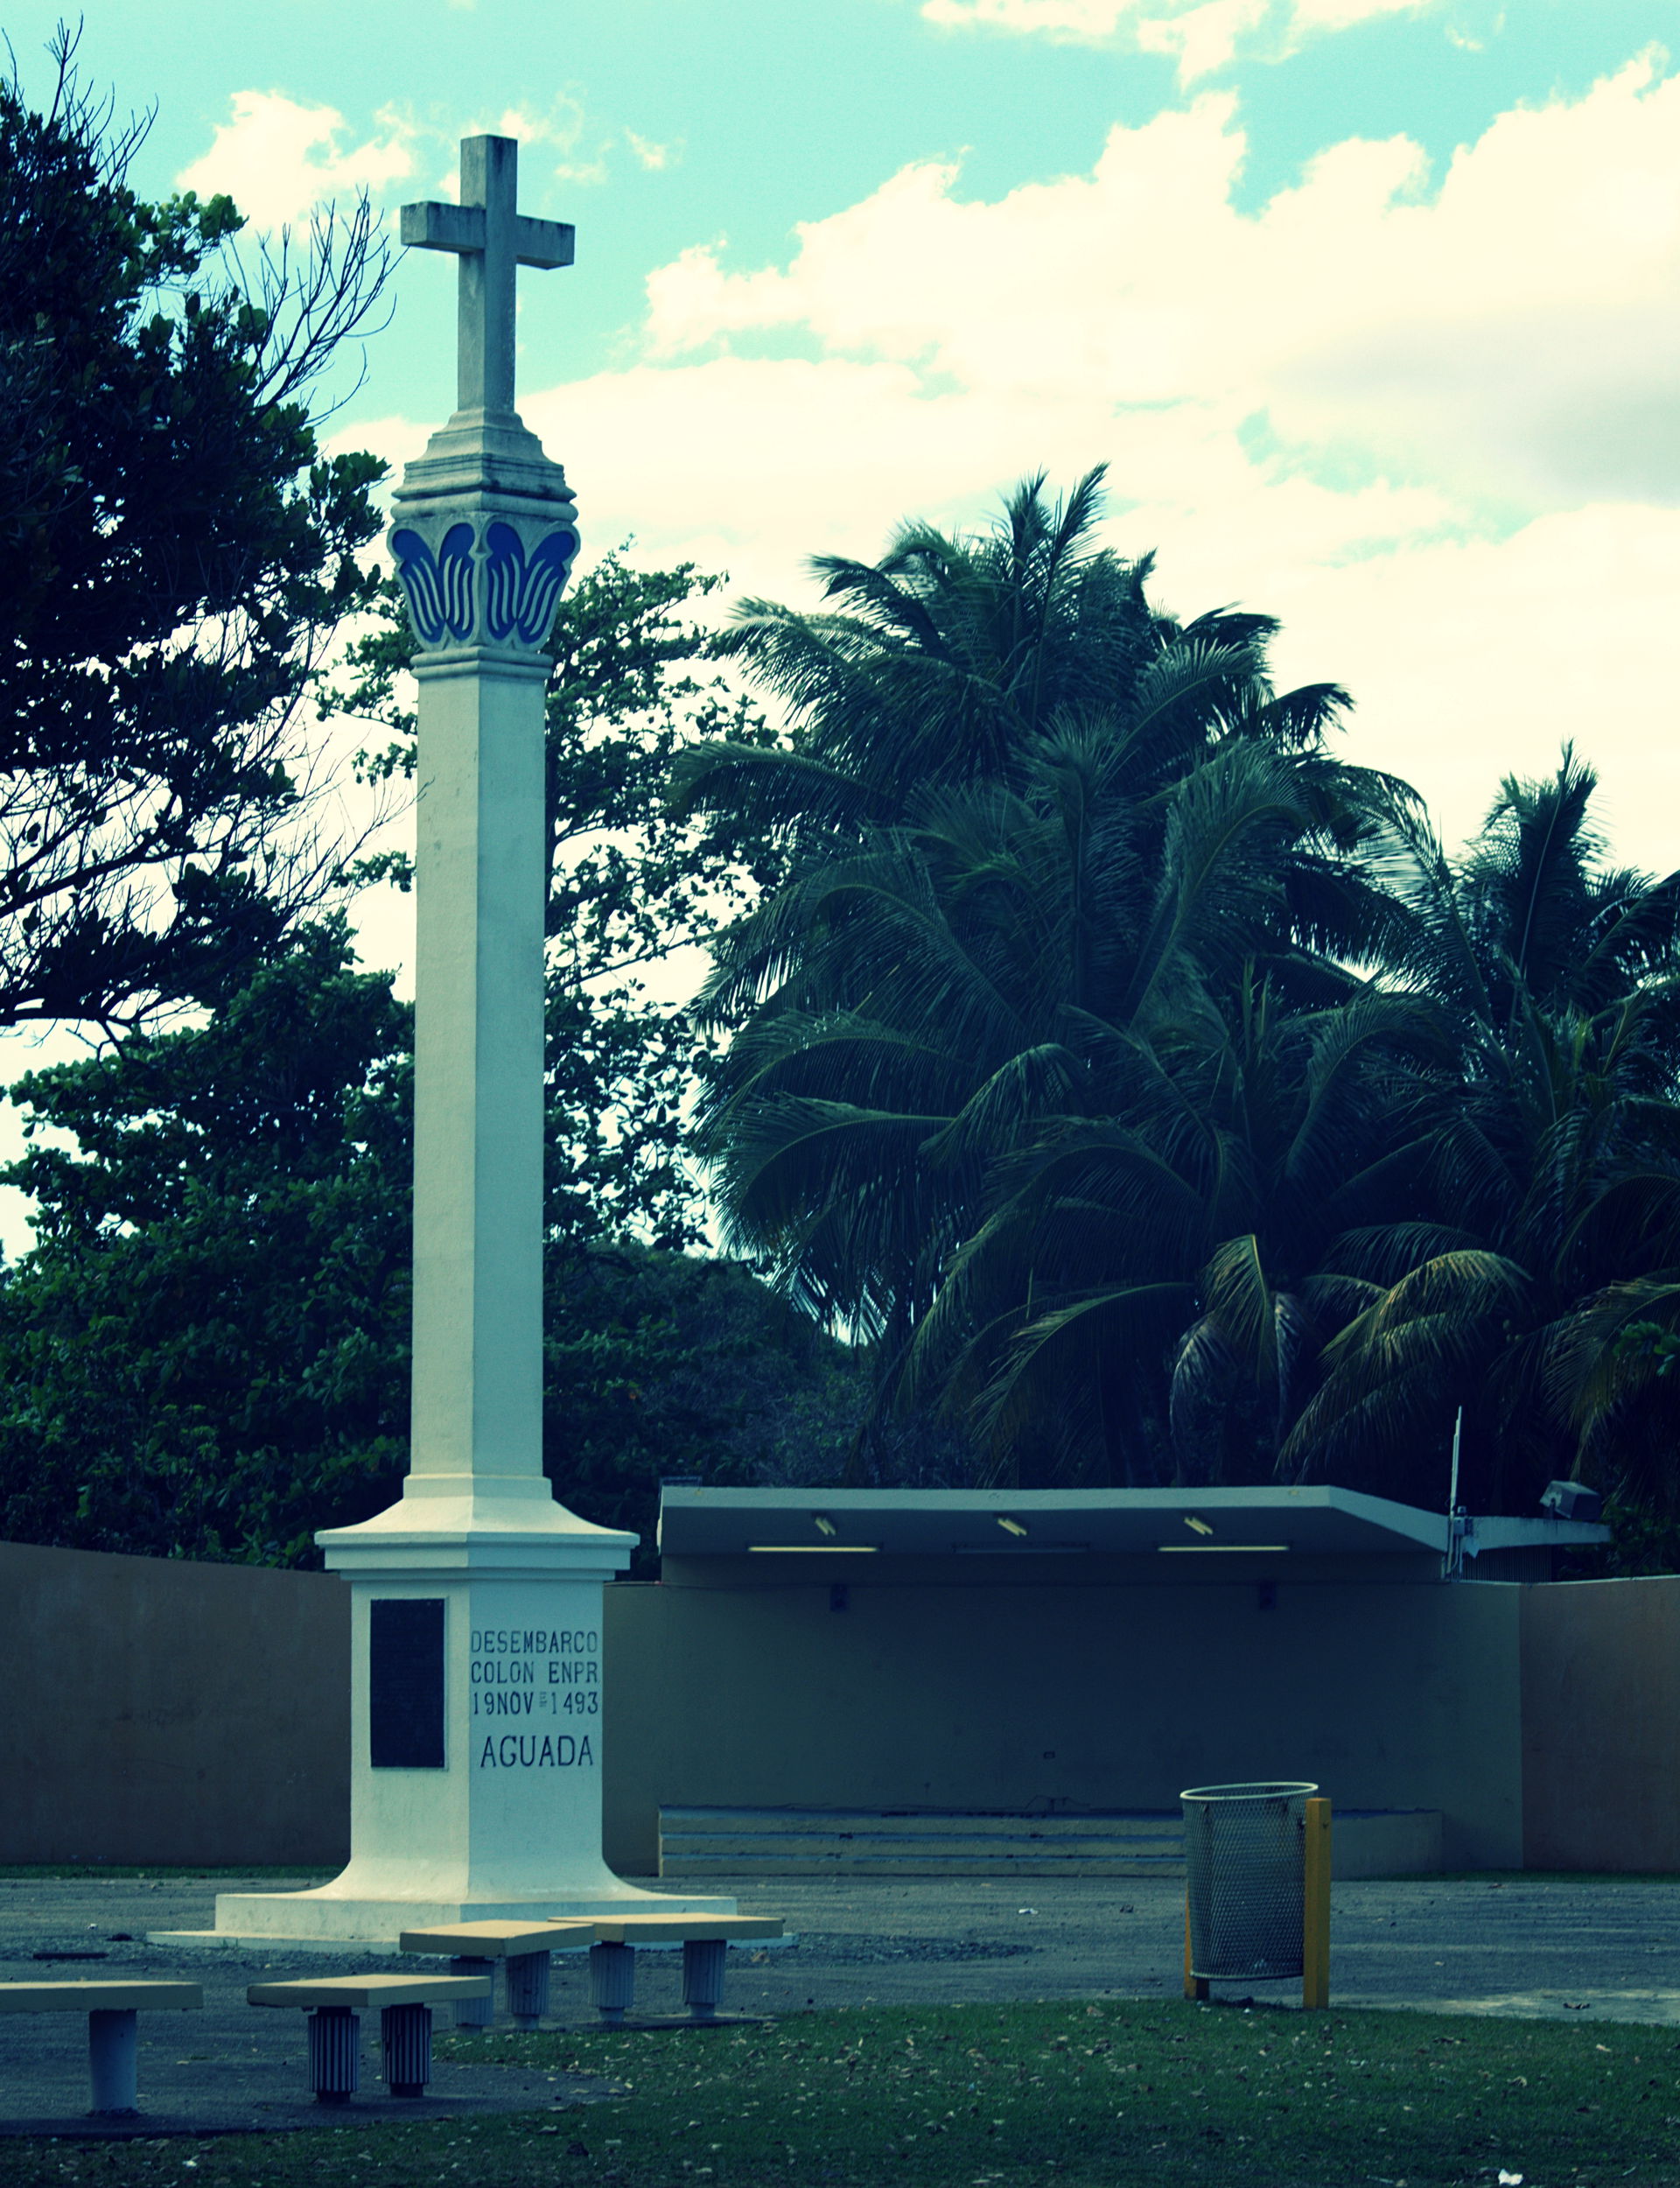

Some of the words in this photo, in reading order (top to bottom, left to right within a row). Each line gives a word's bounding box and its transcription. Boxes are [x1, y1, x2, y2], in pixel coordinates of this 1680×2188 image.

[471, 1630, 598, 1653] DESEMBARCO
[471, 1661, 535, 1684] COLON
[549, 1661, 598, 1684] ENPR
[551, 1692, 598, 1715] 1493
[480, 1735, 593, 1768] AGUADA
